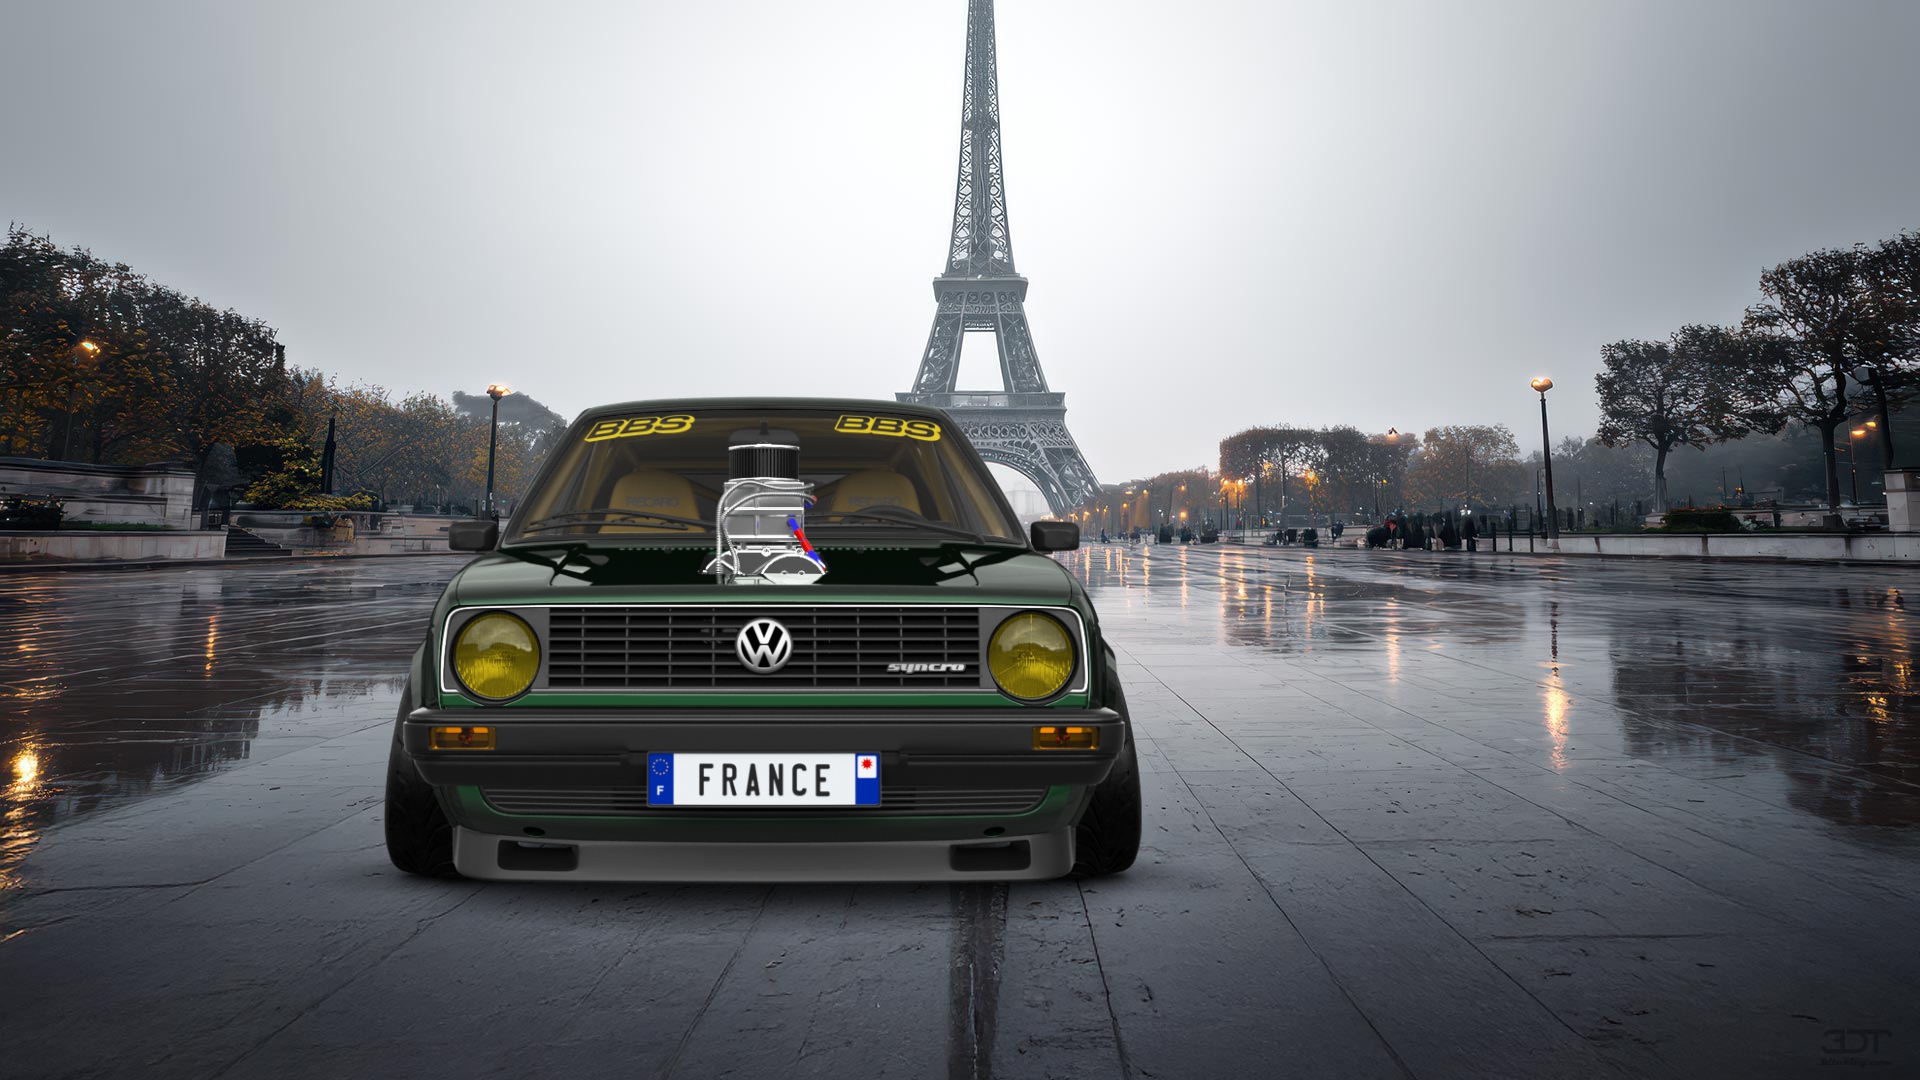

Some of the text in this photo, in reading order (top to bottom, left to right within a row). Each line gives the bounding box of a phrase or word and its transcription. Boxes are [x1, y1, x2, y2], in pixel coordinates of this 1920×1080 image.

[584, 415, 695, 442] BBS
[834, 414, 941, 442] BBS
[625, 496, 680, 508] RECARO
[886, 662, 966, 674] syncro
[698, 763, 831, 797] FRANCE
[656, 785, 665, 796] F
